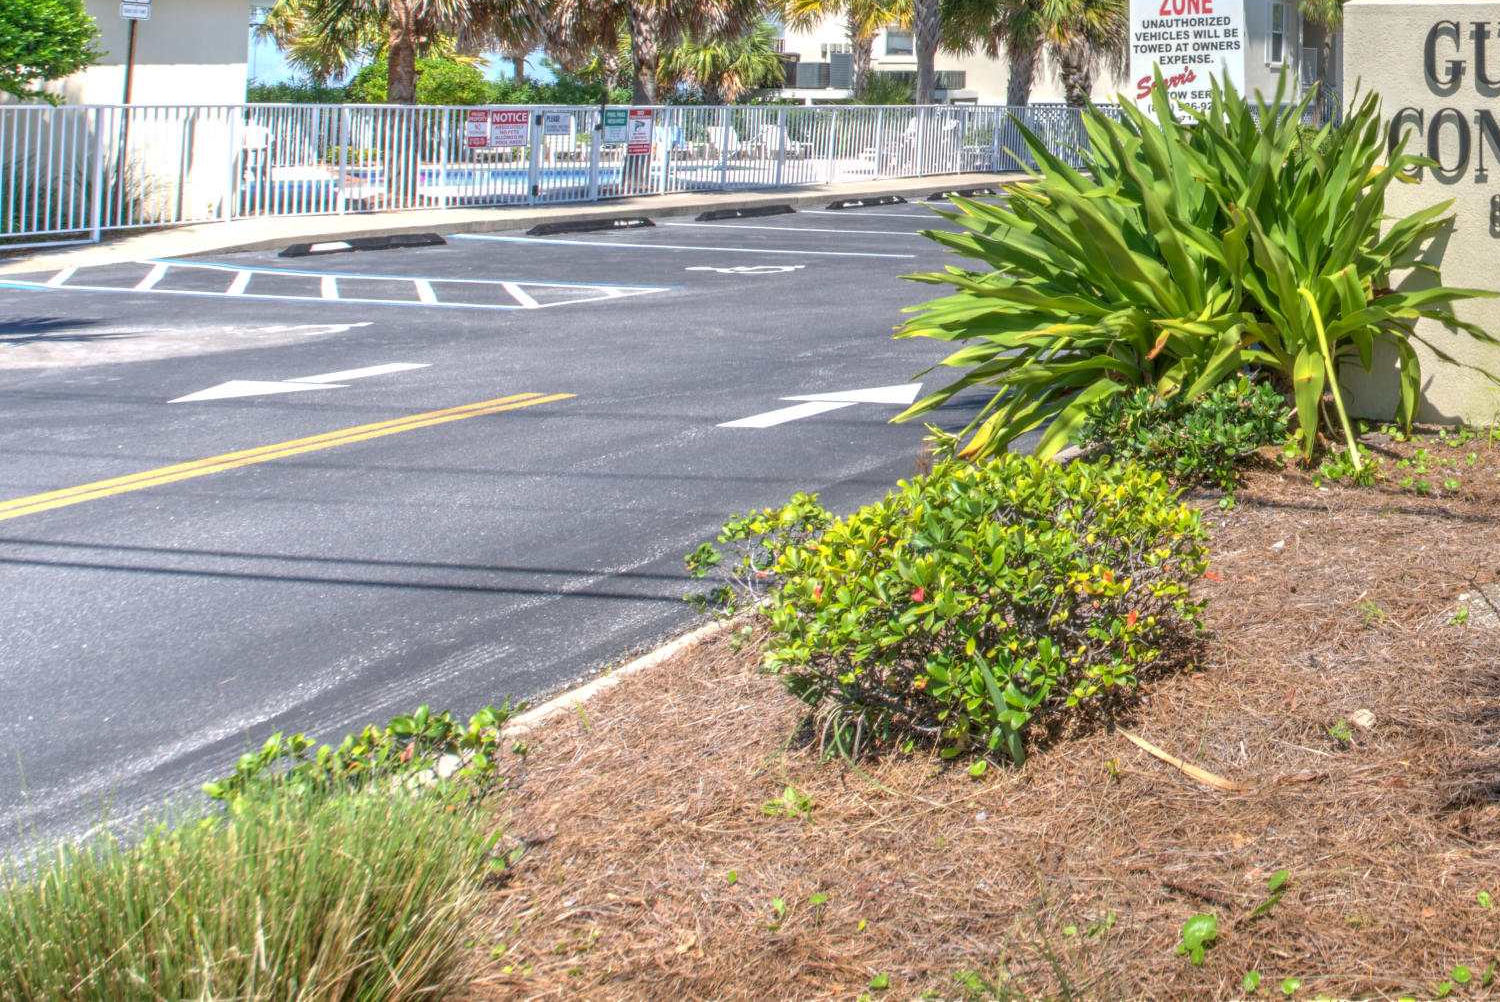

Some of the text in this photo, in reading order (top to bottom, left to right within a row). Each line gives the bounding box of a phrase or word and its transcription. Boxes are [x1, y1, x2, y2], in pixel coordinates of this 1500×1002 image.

[1142, 16, 1231, 29] UNAUTHORIZED
[1135, 28, 1239, 42] VEHICLES WILL BE
[1133, 41, 1241, 54] TOWED AT OWNERS
[1159, 54, 1214, 65] EXPENSE.
[1164, 90, 1187, 100] OW
[492, 112, 528, 123] NOTICE
